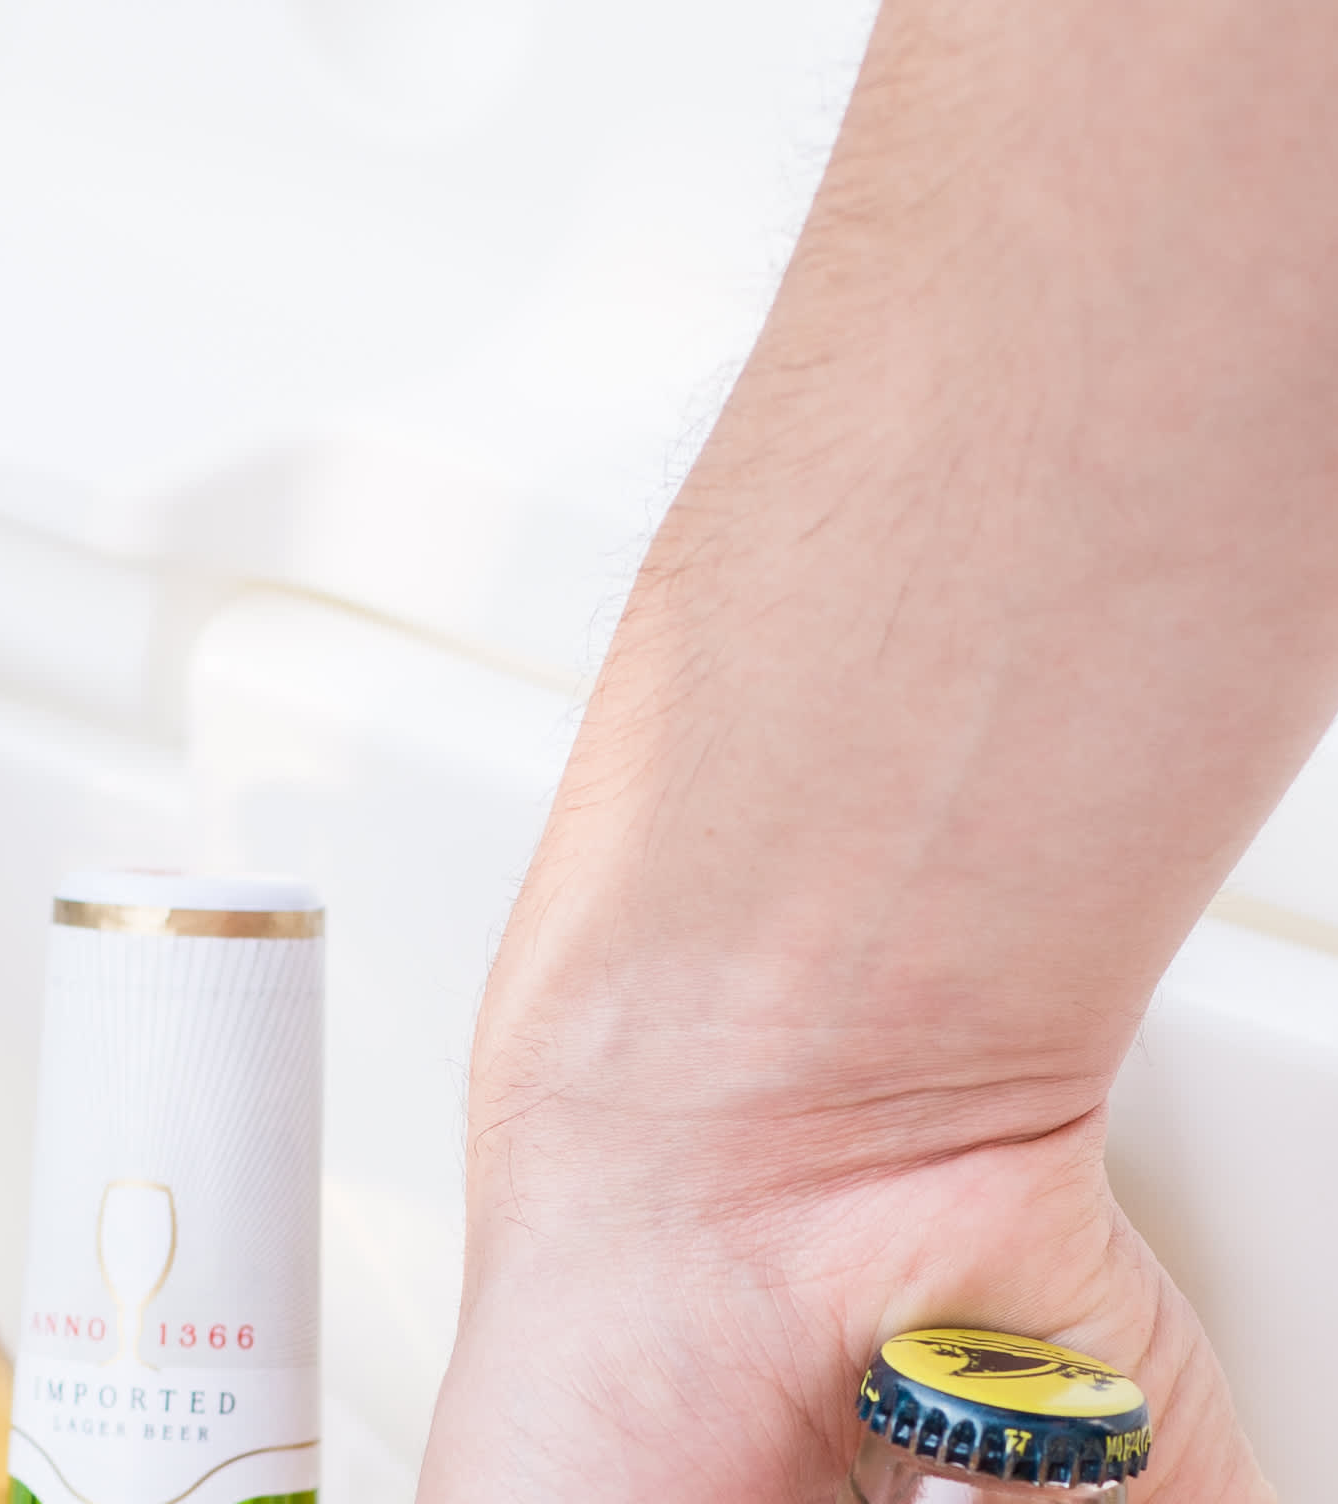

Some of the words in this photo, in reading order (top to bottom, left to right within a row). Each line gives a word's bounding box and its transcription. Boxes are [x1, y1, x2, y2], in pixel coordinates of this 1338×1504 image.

[30, 1312, 106, 1341] ANNO
[159, 1322, 255, 1350] 1366
[33, 1376, 236, 1415] IMPORTED
[52, 1416, 126, 1437] LAGER
[143, 1424, 209, 1441] BEER
